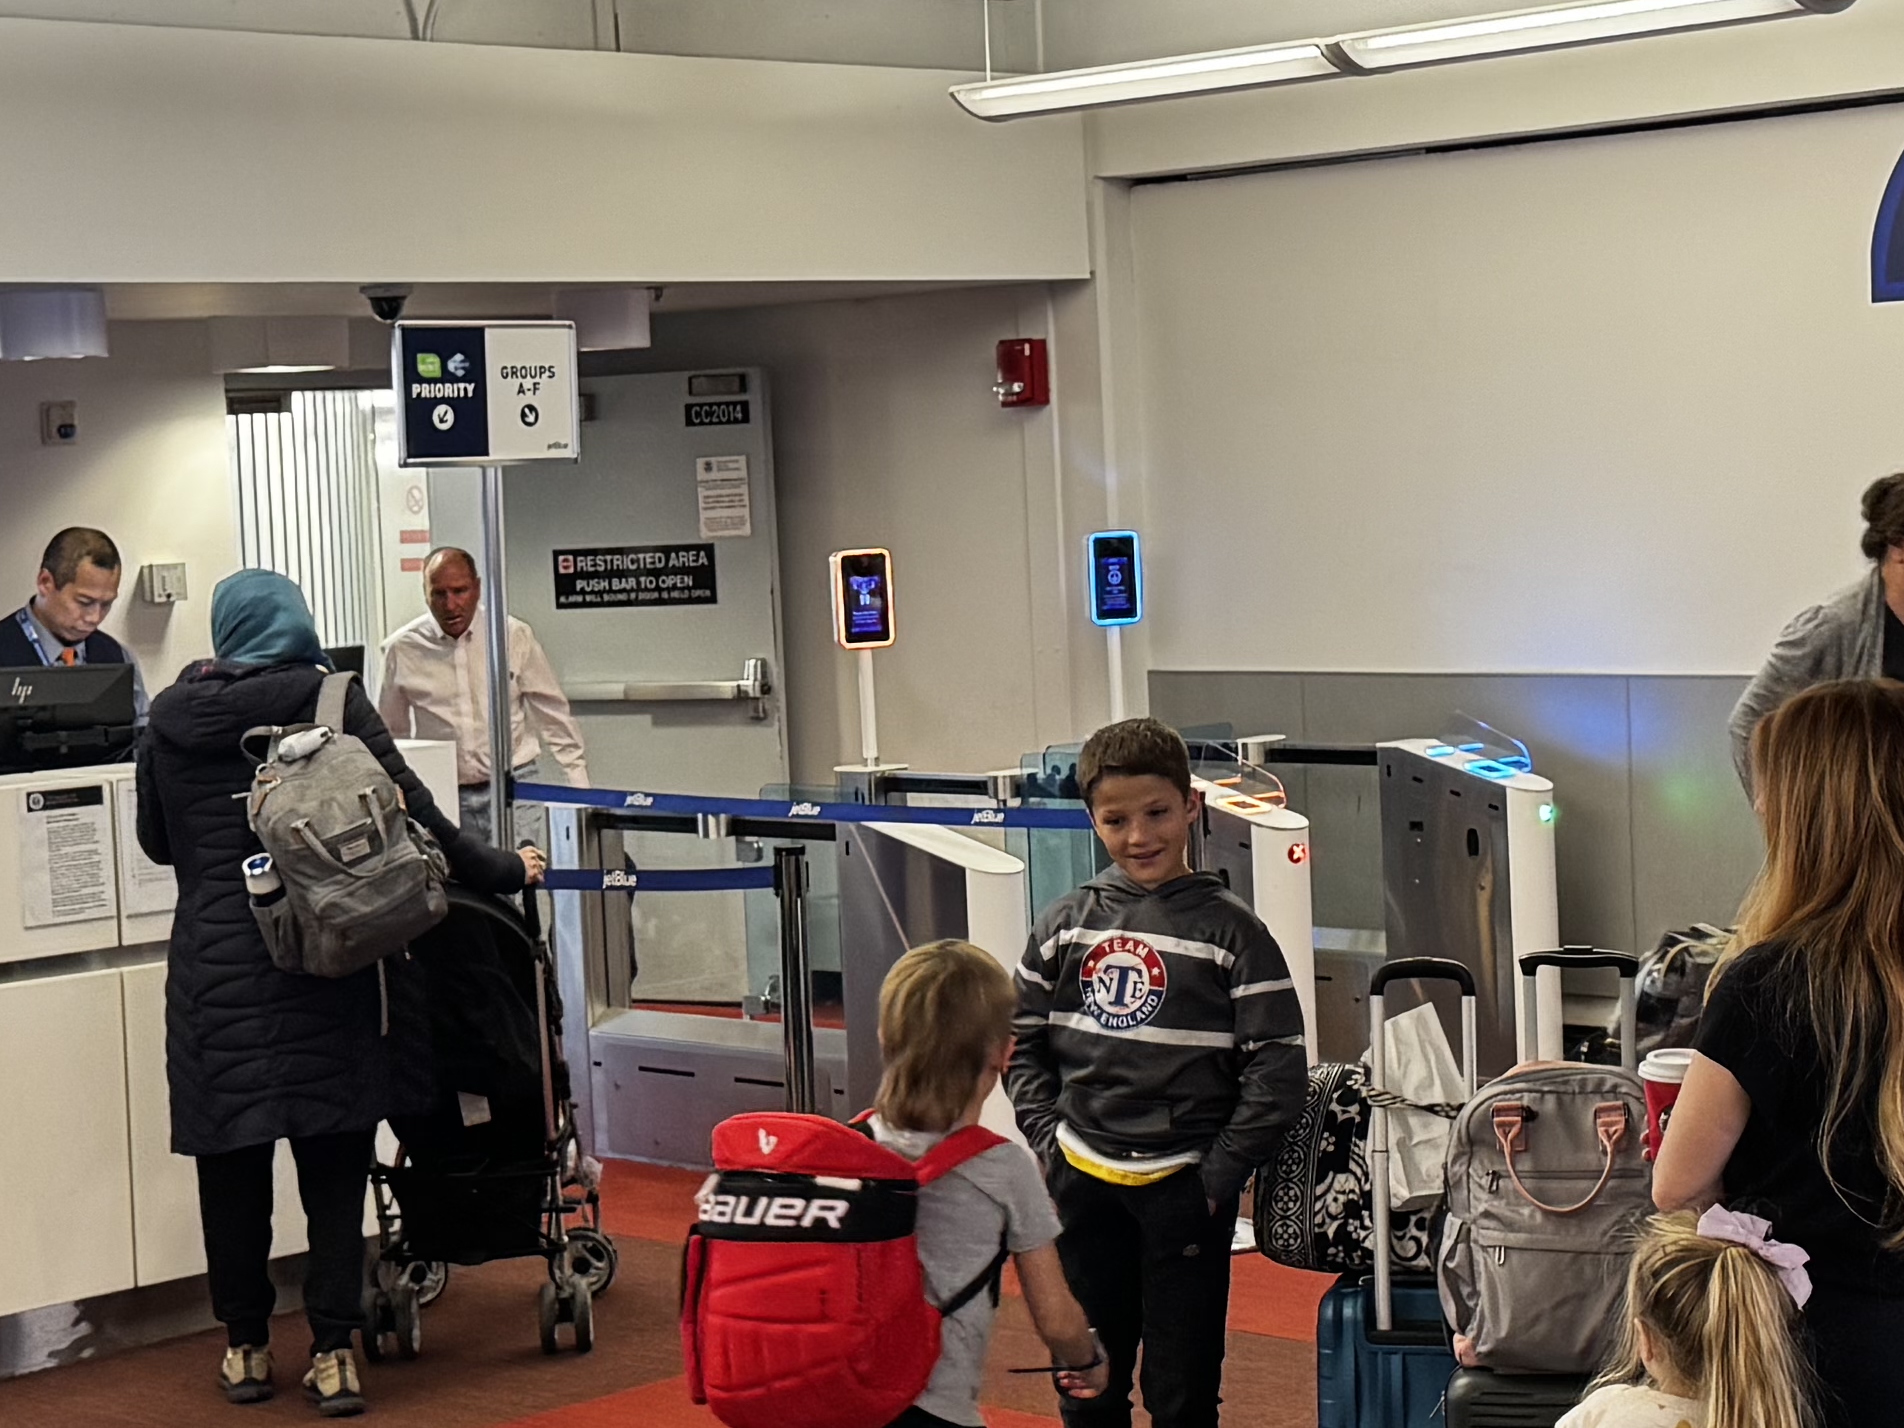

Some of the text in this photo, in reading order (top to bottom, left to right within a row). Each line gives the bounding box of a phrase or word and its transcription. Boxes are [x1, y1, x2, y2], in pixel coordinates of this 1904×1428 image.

[500, 365, 556, 380] GROUPS
[411, 382, 475, 399] PRIORITY
[516, 382, 541, 397] A-F
[691, 404, 743, 424] CC2014
[576, 550, 708, 572] RESTRICTED AREA
[576, 574, 693, 592] PUSH BAR TO OPEN
[1102, 938, 1149, 959] TEAM
[1100, 995, 1158, 1027] ENGLAND
